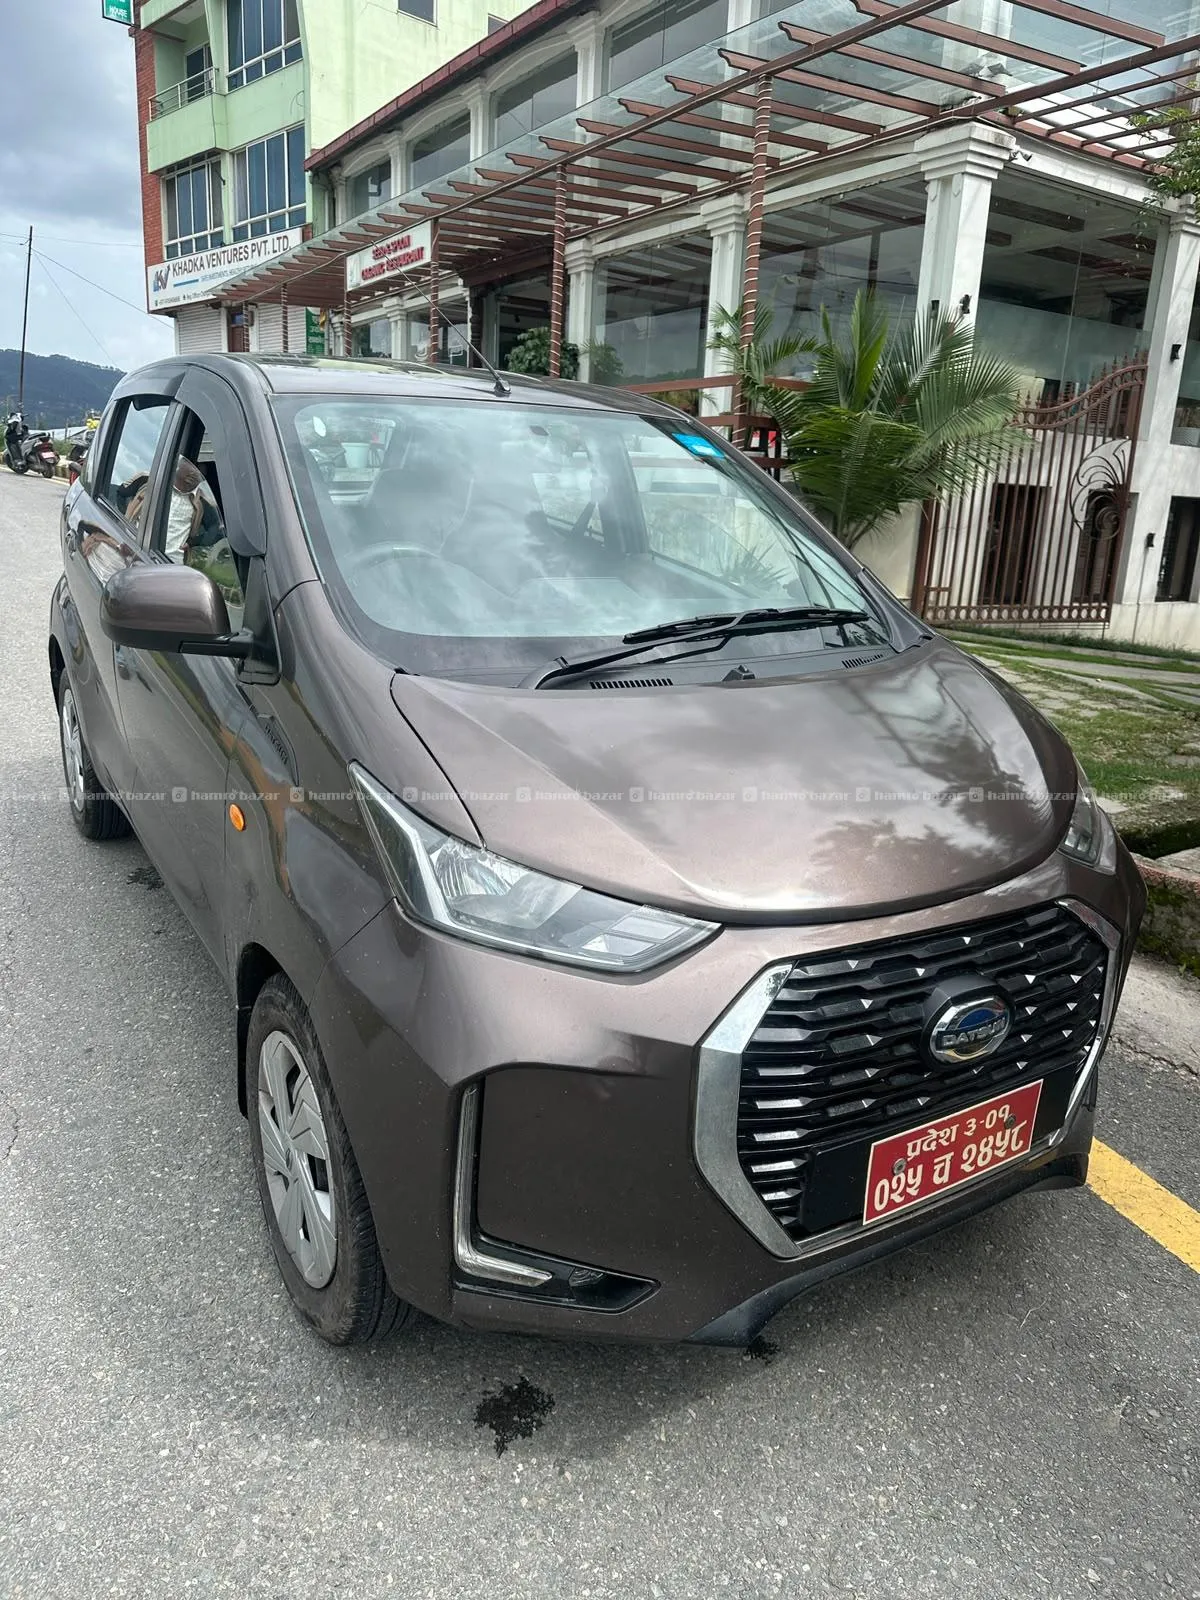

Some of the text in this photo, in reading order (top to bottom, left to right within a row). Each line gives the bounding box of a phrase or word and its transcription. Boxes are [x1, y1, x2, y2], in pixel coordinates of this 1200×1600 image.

[172, 257, 205, 277] KHADKA
[206, 244, 249, 268] VENTURES
[251, 239, 270, 260] PVT.
[272, 235, 292, 253] LTD.
[942, 1016, 1006, 1046] DATSUN
[907, 1123, 960, 1161] प्रदेश
[874, 1120, 1028, 1211] ०२५ च २४५८
